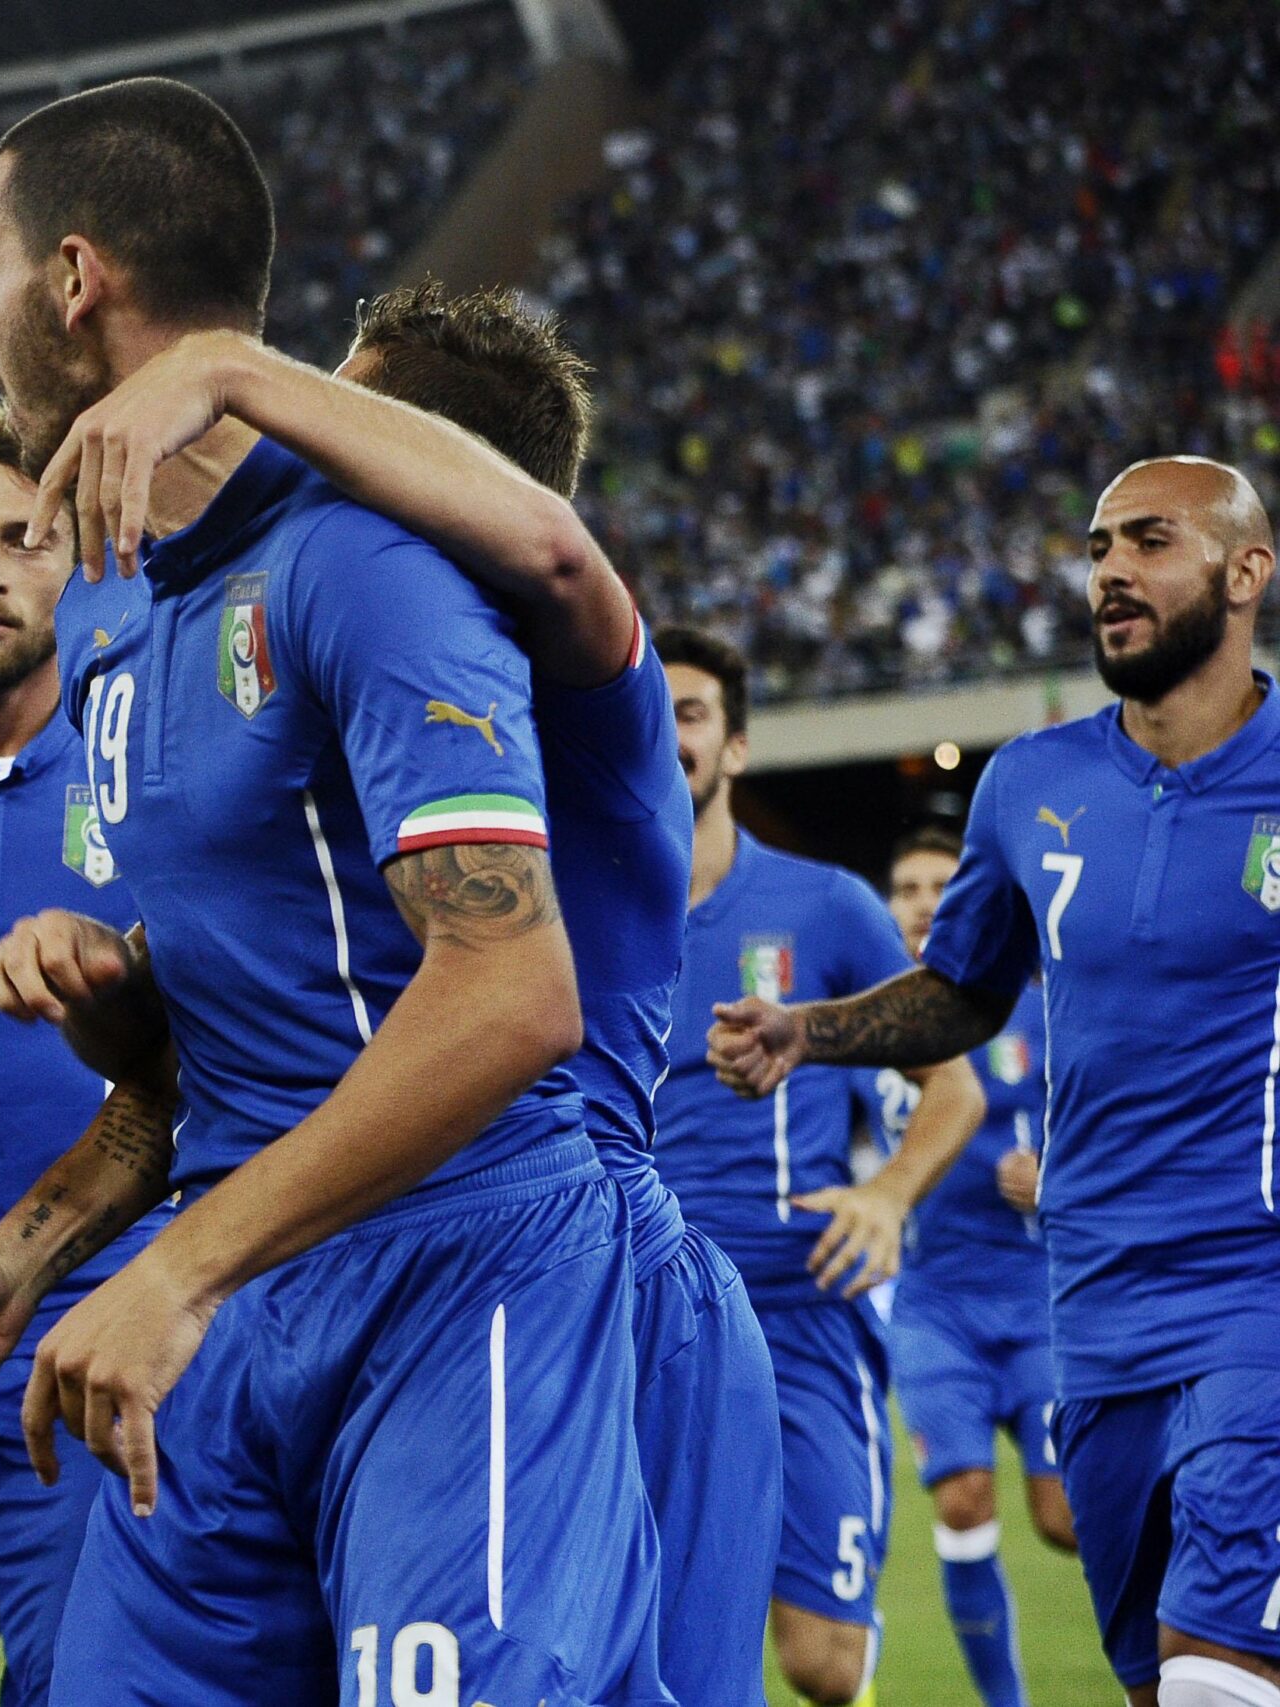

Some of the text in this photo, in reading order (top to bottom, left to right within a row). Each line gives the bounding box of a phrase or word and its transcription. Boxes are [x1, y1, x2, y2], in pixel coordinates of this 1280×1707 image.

[89, 672, 135, 824] 19
[1042, 851, 1084, 961] 7
[832, 1514, 867, 1601] 5
